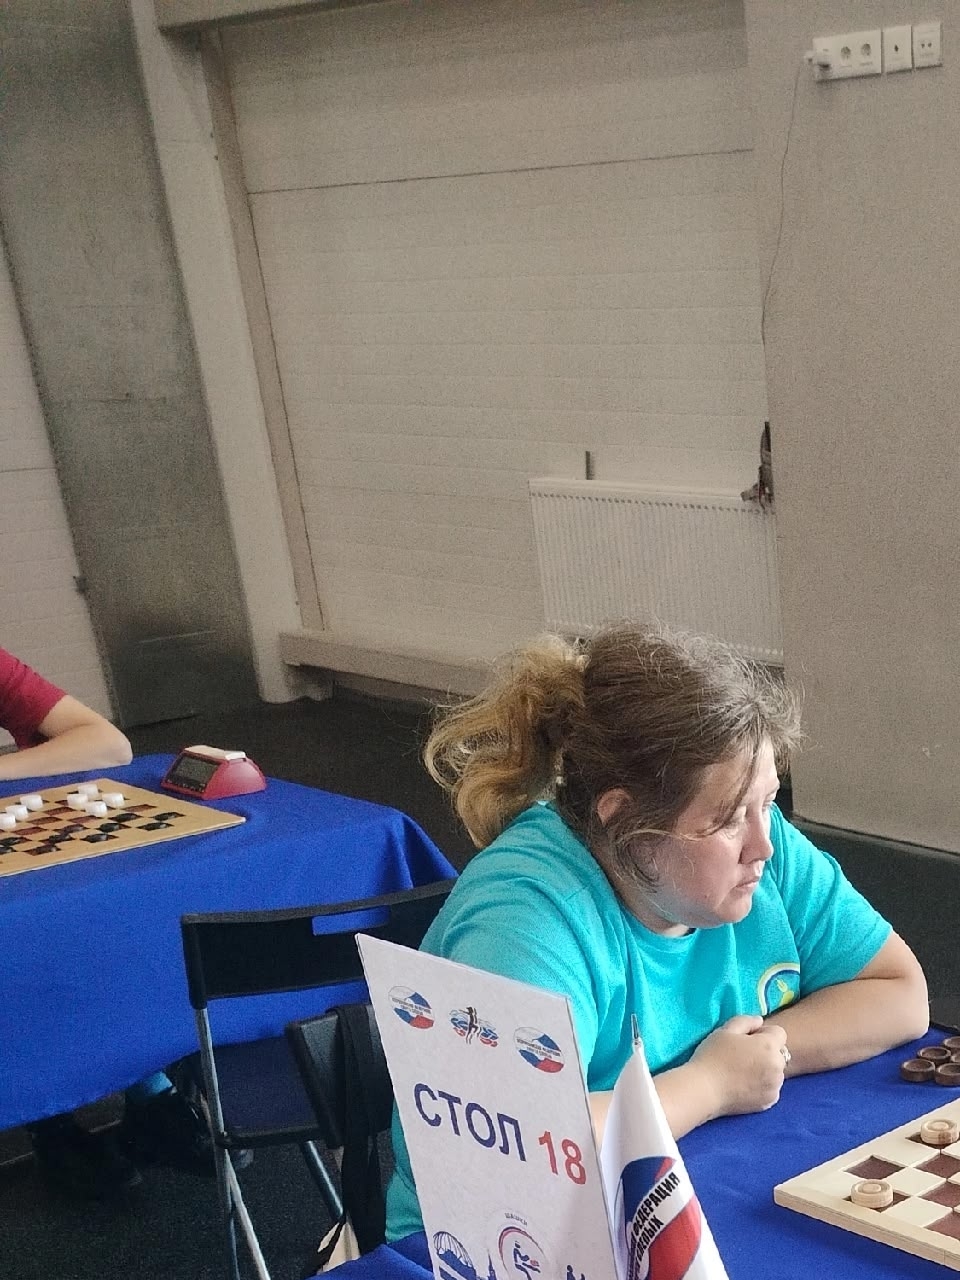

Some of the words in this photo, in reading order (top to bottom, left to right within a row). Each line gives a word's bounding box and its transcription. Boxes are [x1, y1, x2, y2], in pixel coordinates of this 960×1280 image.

[414, 1083, 526, 1162] СТОЛ
[538, 1131, 587, 1185] 18
[632, 1172, 680, 1237] ФЕДЕРАЦИЯ
